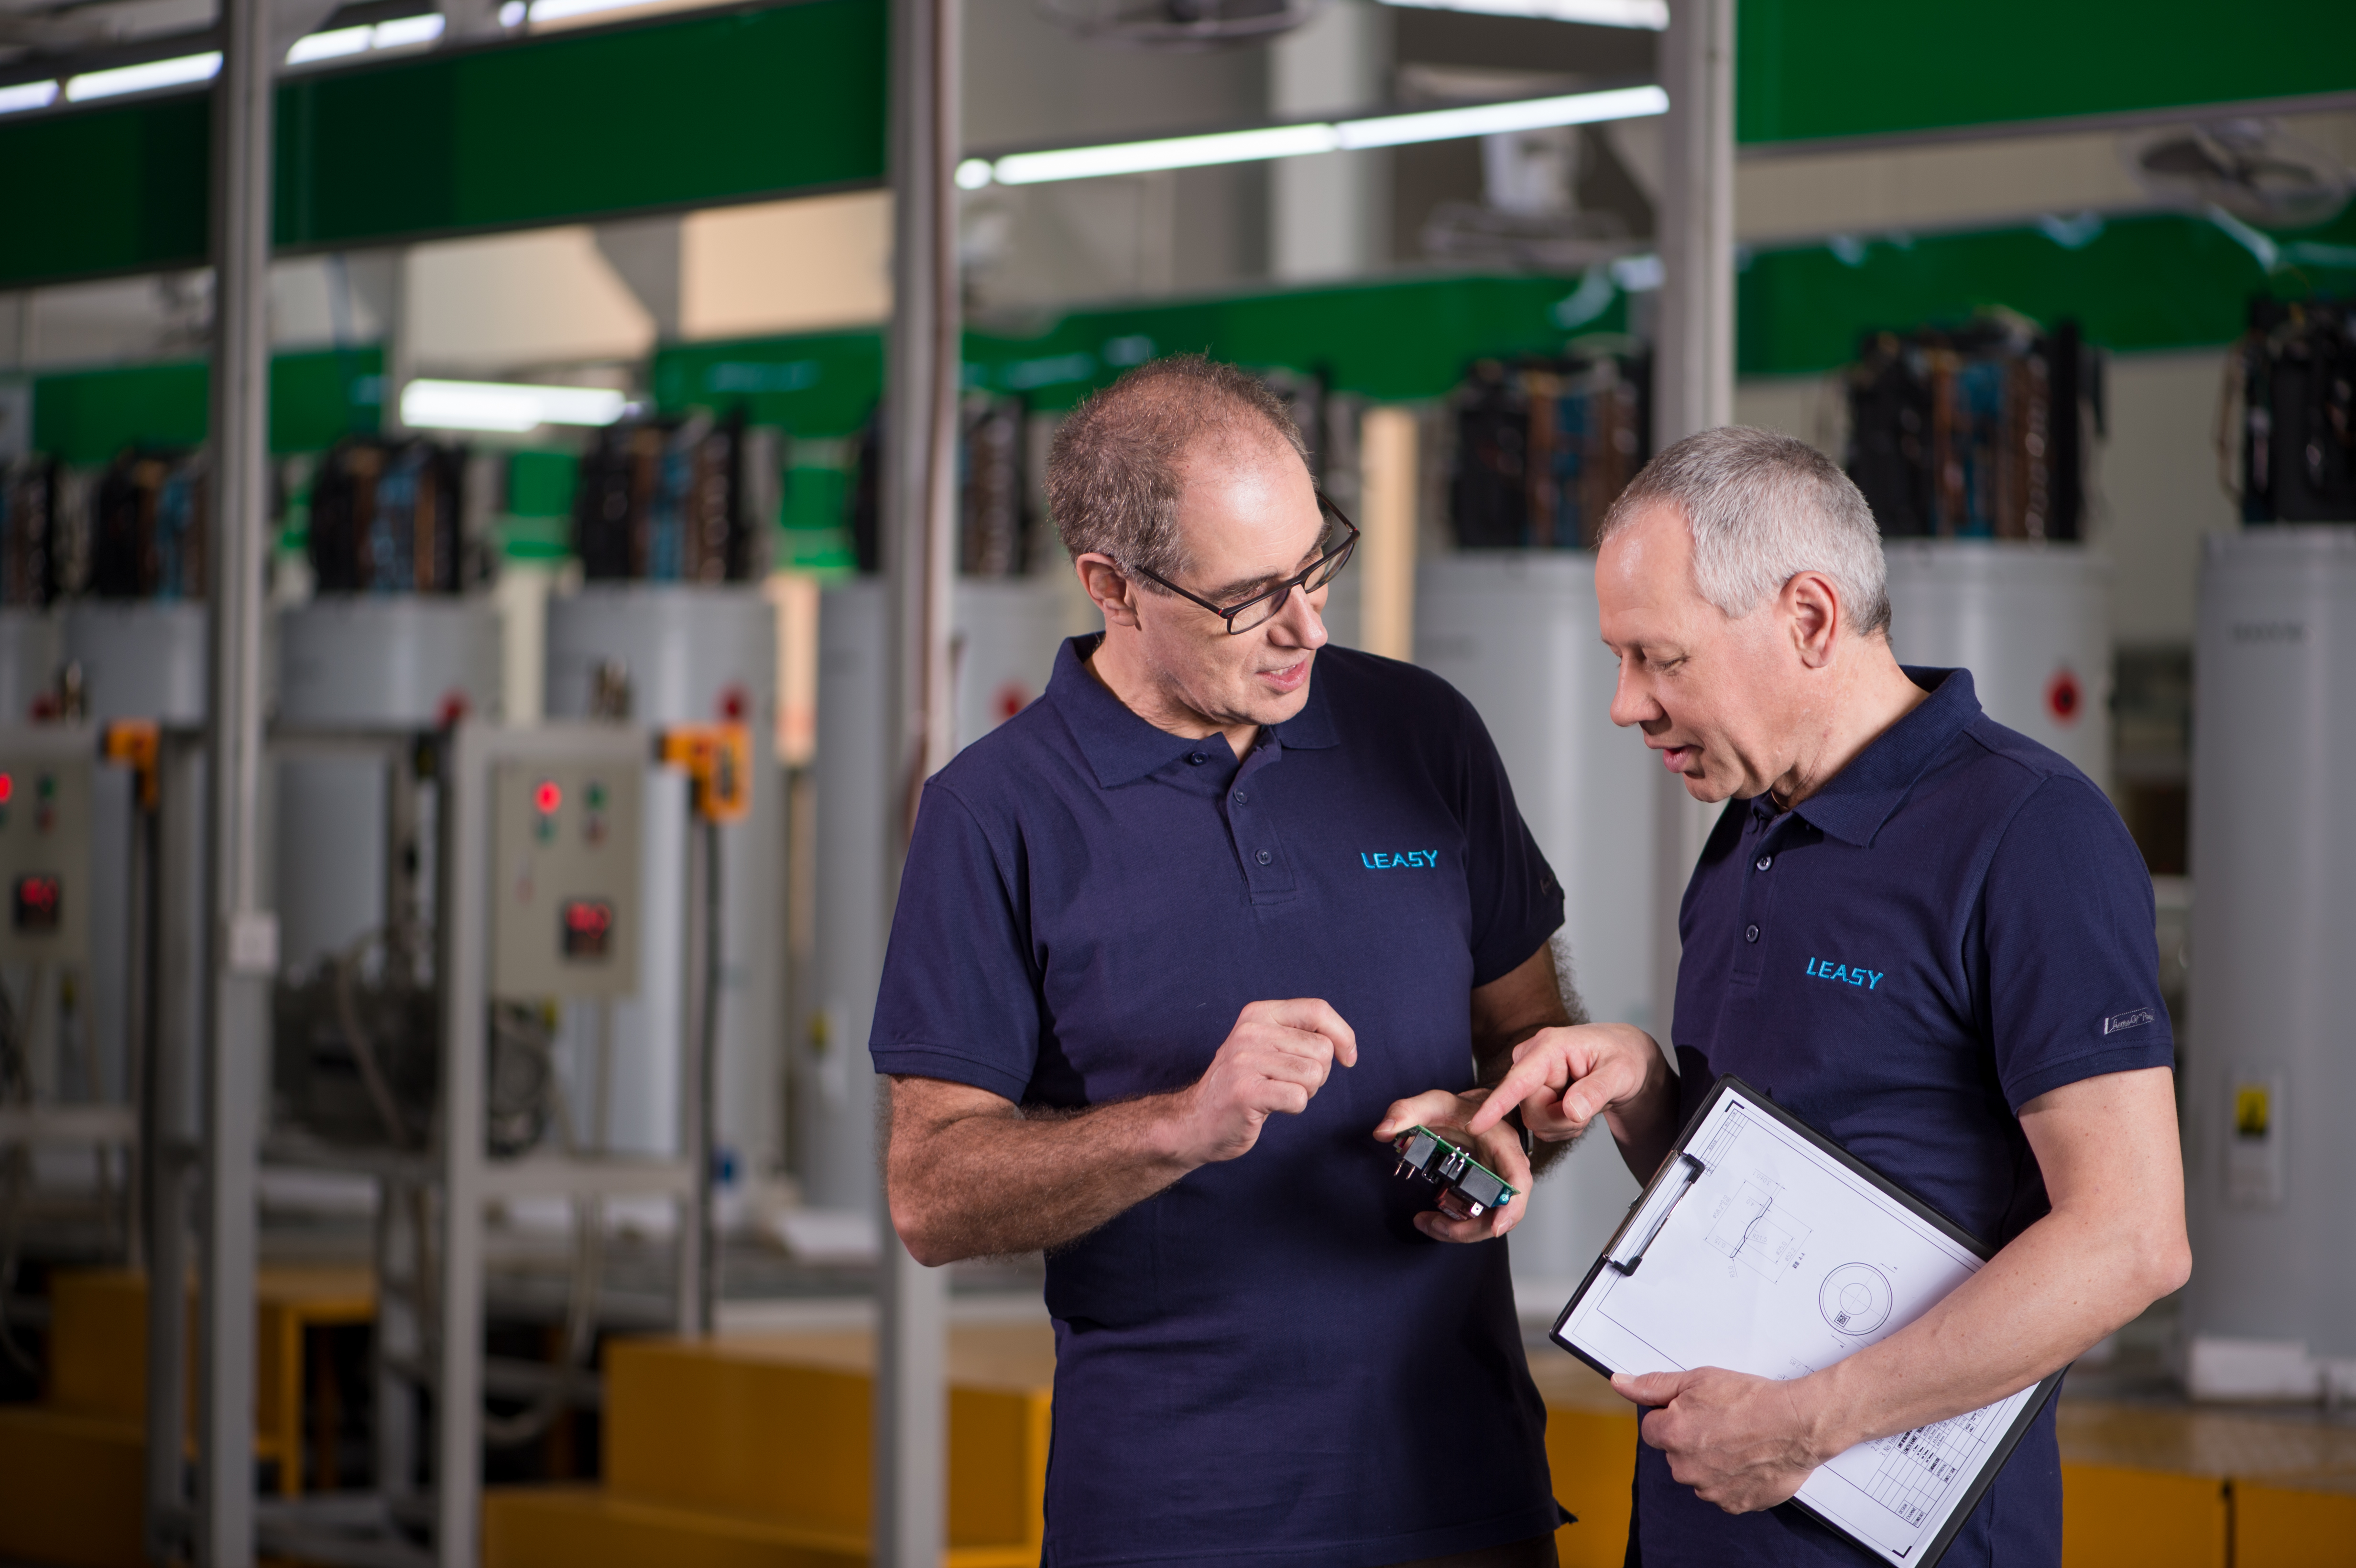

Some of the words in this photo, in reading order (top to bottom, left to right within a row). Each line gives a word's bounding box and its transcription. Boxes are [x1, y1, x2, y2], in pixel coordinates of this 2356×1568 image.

[1361, 849, 1438, 869] LEASY
[1806, 957, 1884, 990] LEASY
[1753, 1171, 1772, 1186] 3.0±0.1
[1714, 1238, 1725, 1248] 0.15
[1752, 1233, 1767, 1242] R21.5
[1789, 1359, 1801, 1370] 2.85
[1959, 1416, 1967, 1426] TRIAL
[1909, 1436, 1918, 1445] RANGE
[1937, 1463, 1947, 1477] APPROVAL
[1898, 1503, 1908, 1514] DESIGN
[1906, 1507, 1916, 1520] EXAMINE
